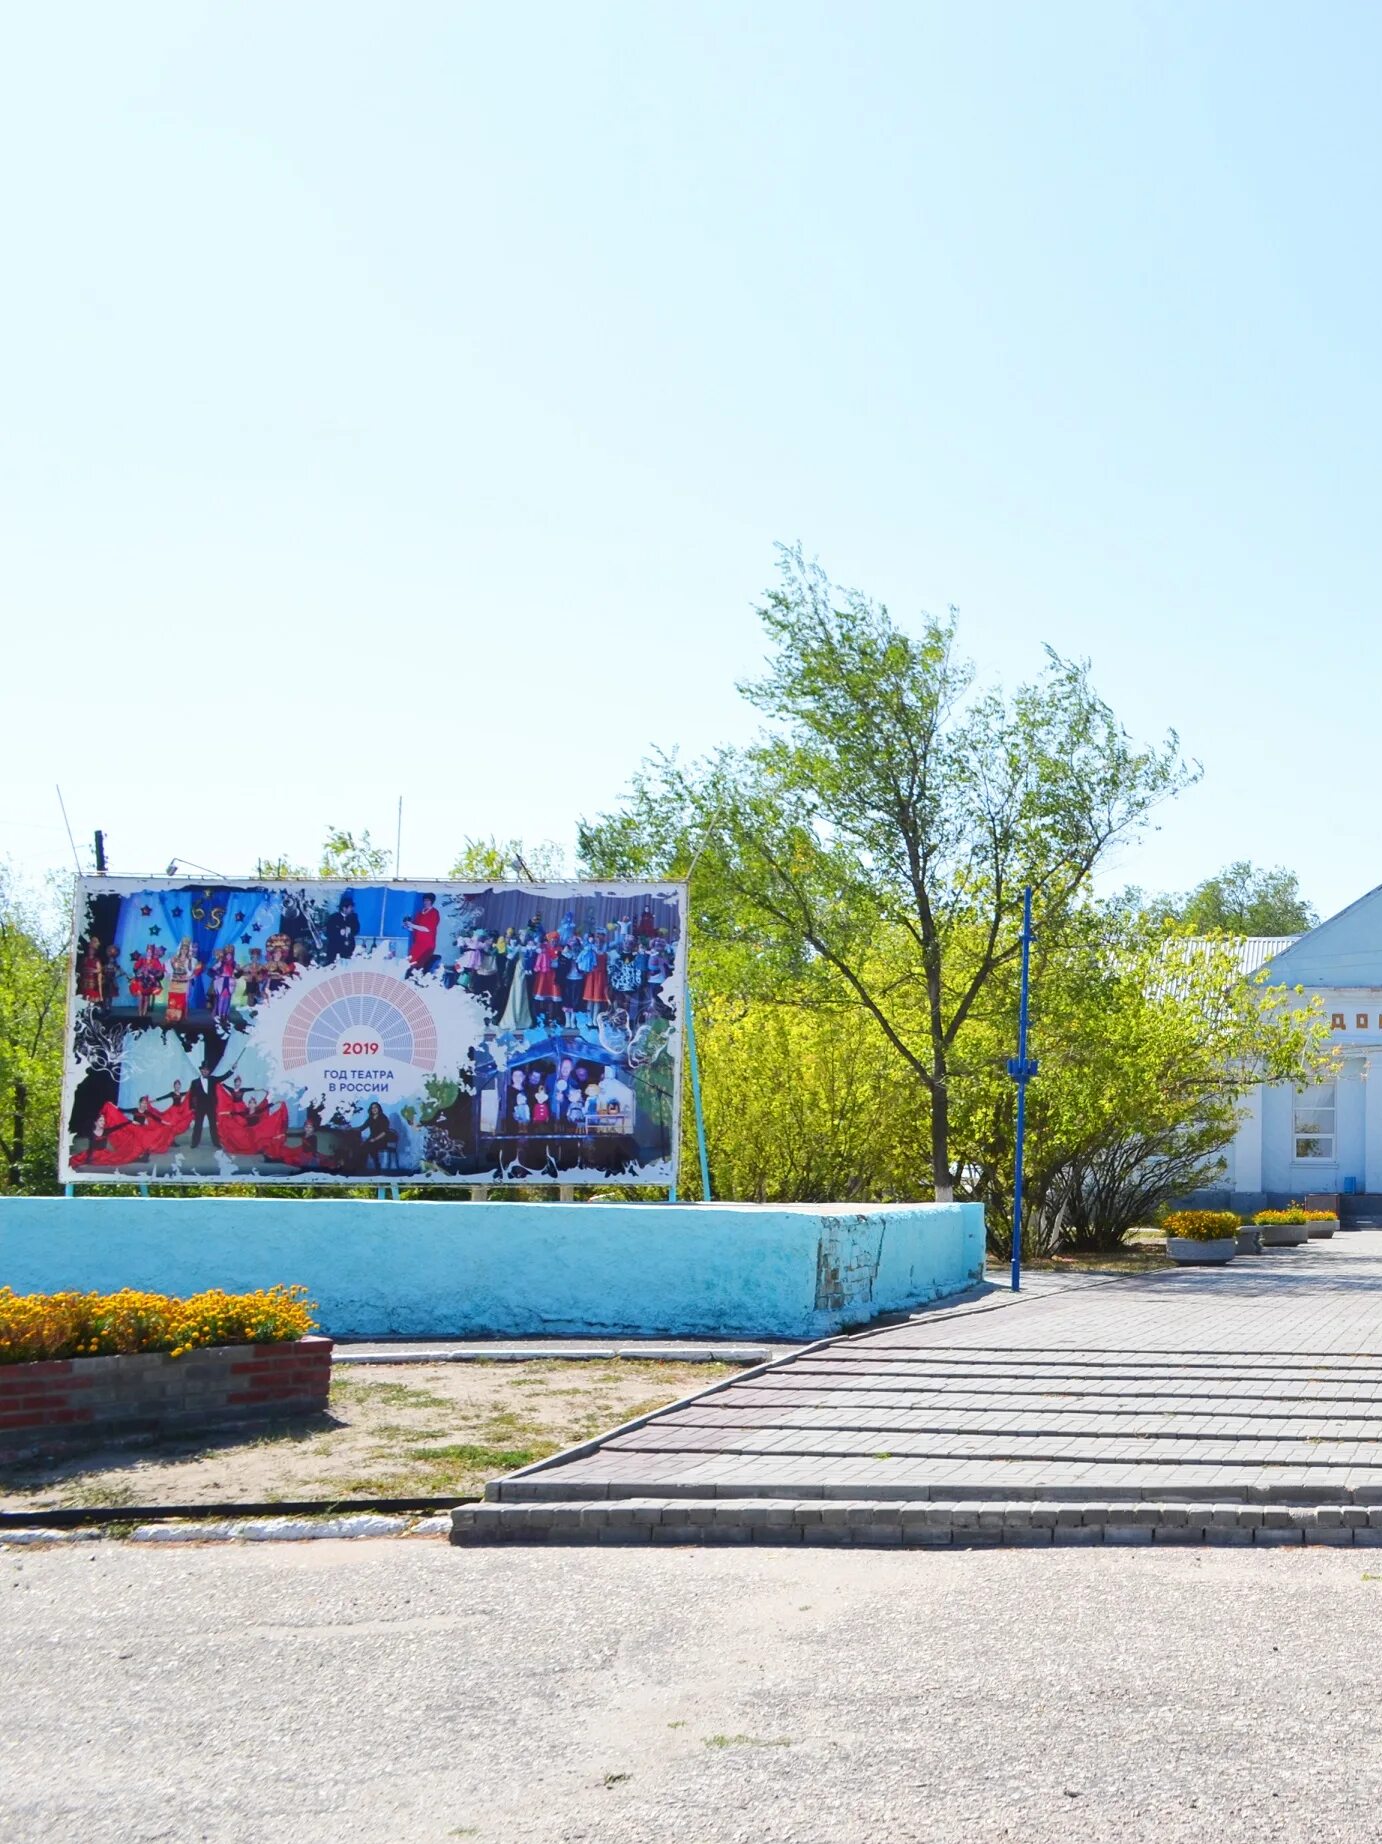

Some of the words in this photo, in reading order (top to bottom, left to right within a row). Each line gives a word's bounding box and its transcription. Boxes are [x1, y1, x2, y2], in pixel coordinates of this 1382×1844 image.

[342, 1042, 379, 1055] 2019
[324, 1070, 347, 1080] ГОД
[350, 1070, 394, 1079] ТЕАТРА
[329, 1083, 336, 1092] В
[340, 1083, 389, 1092] РОССИИ
